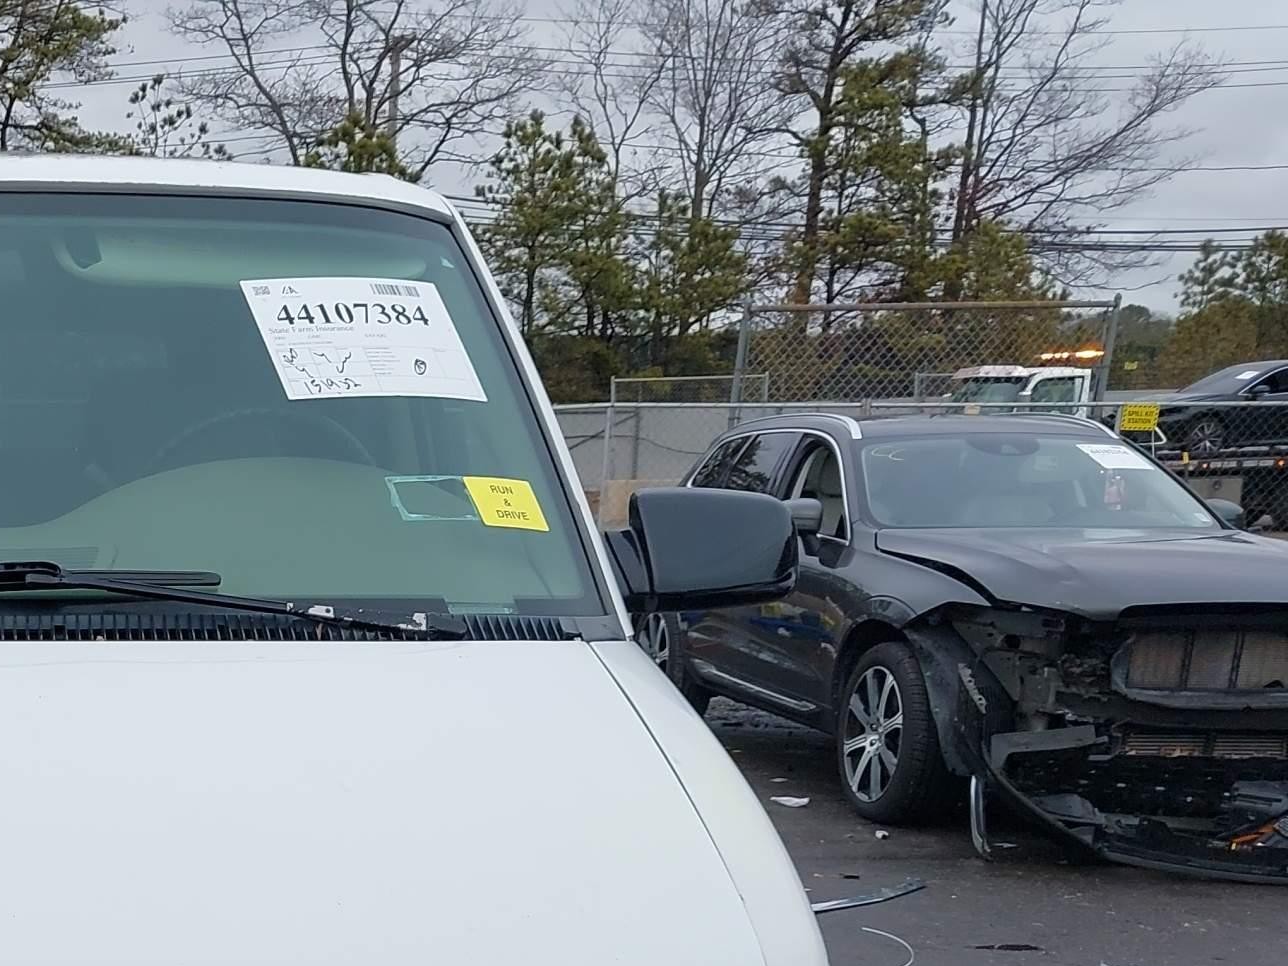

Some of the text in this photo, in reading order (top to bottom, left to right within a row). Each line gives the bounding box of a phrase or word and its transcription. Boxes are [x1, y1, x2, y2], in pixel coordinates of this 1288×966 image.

[277, 302, 430, 327] 44107384
[489, 485, 513, 495] RUN
[504, 498, 511, 506] &
[496, 509, 530, 521] DRIVE
